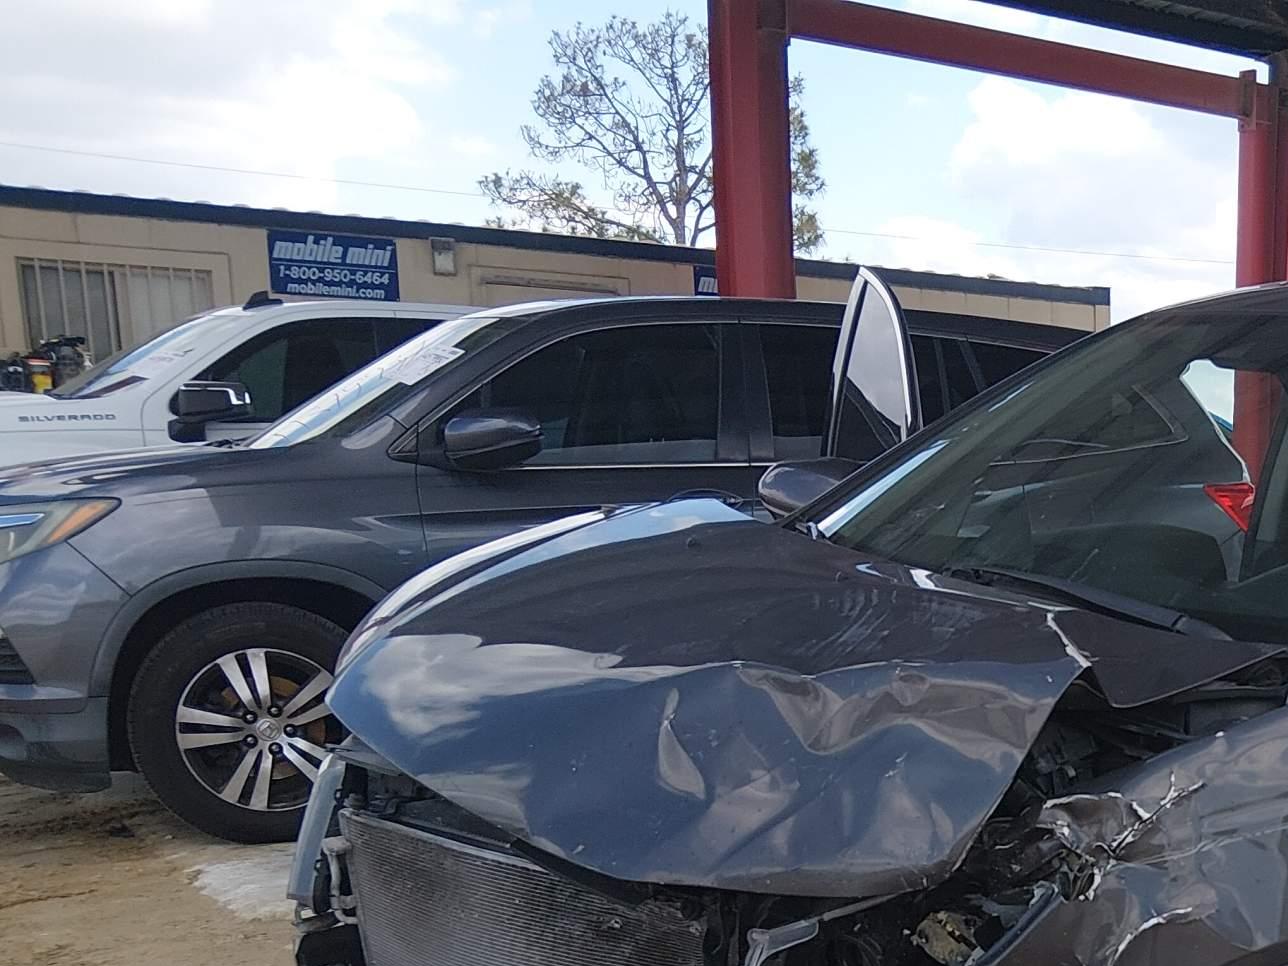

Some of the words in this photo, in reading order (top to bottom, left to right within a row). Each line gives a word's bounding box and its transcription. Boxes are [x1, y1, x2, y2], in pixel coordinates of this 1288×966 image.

[272, 235, 344, 263] mobile
[346, 243, 394, 267] mini
[279, 265, 390, 285] 1-800-950-6464
[286, 282, 385, 299] mobilemini.com
[18, 413, 116, 422] SILVERADO
